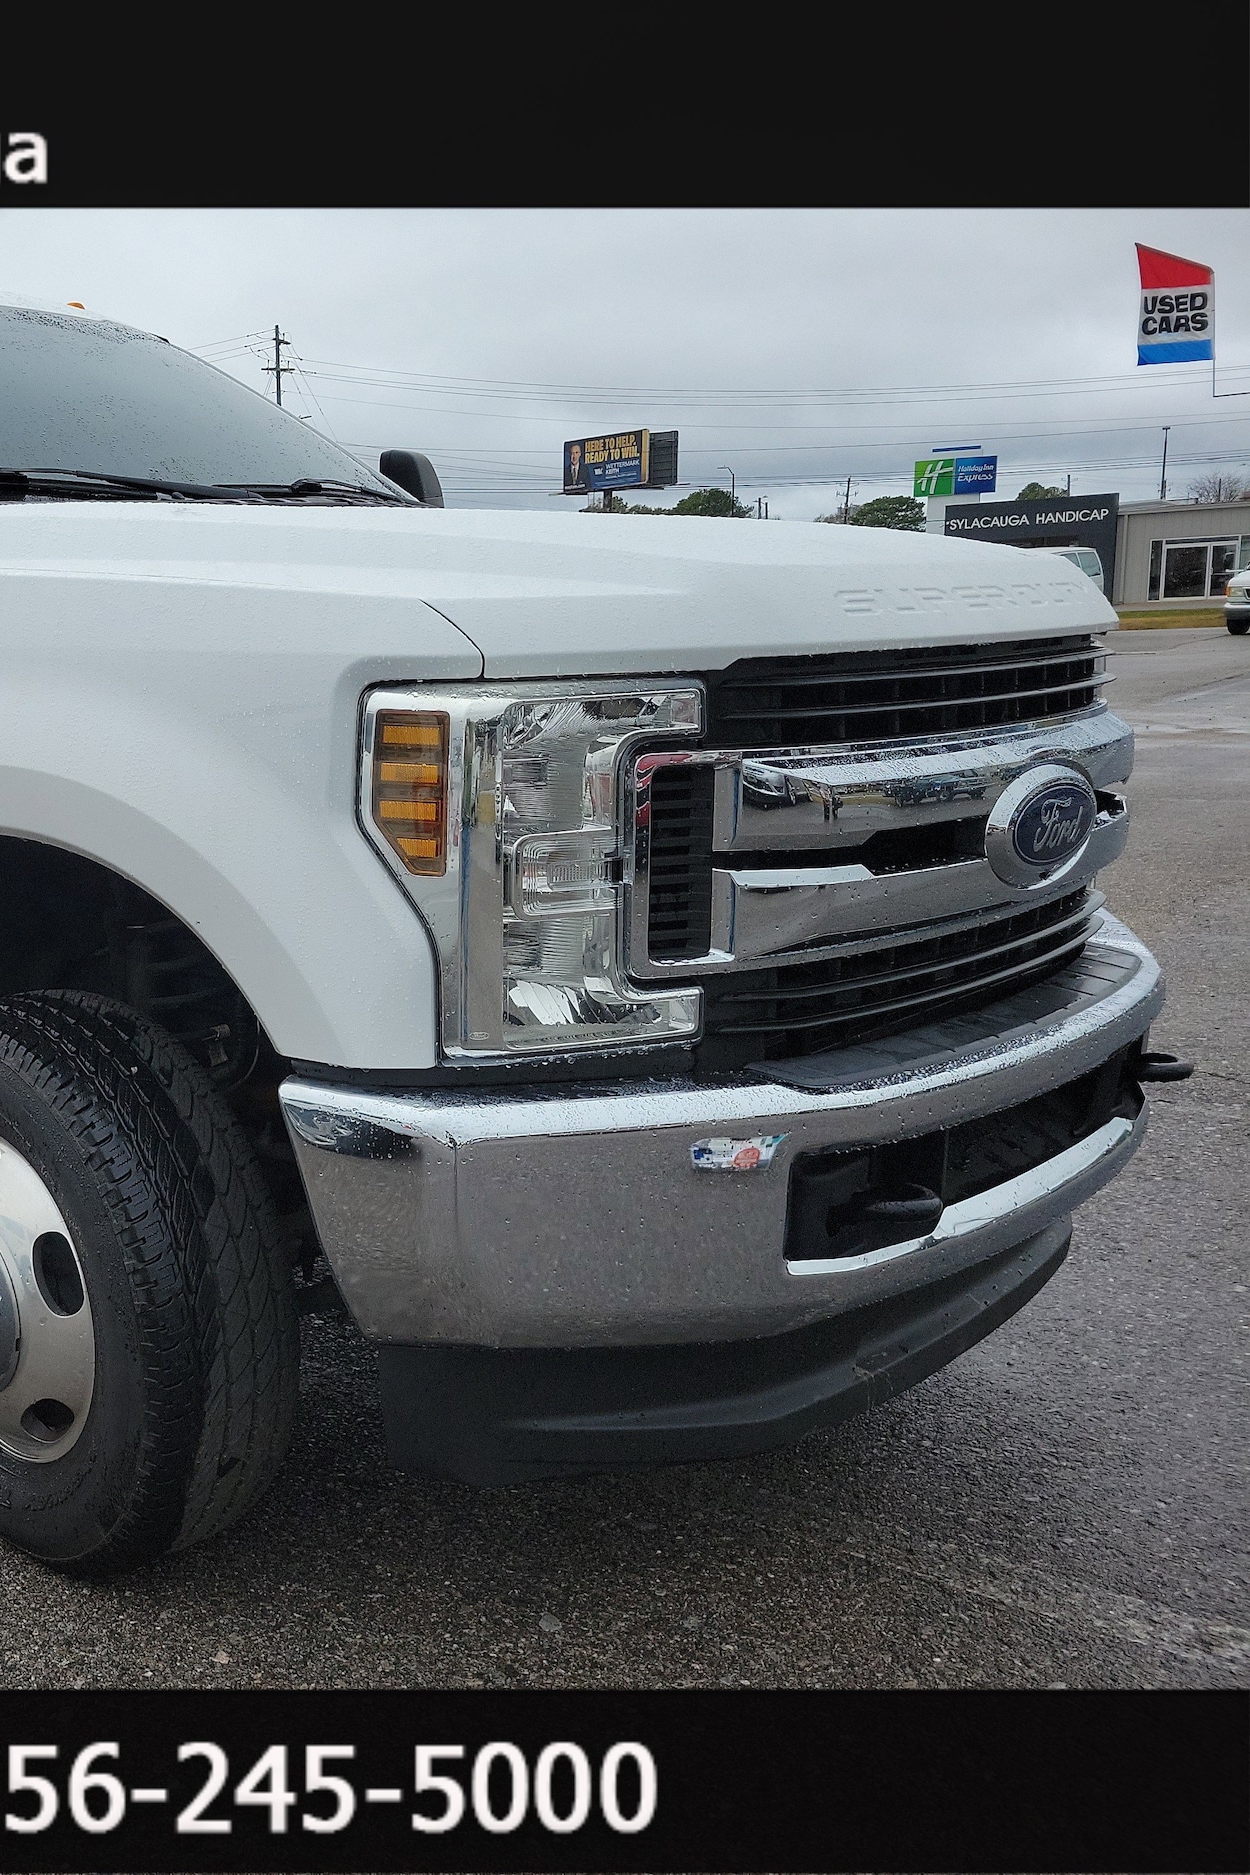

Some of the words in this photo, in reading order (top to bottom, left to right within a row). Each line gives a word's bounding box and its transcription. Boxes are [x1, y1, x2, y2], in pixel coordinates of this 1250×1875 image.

[1144, 292, 1208, 314] USED
[1142, 313, 1209, 335] CARS
[585, 440, 604, 452] HERE
[605, 438, 616, 449] TO
[616, 434, 636, 448] HELP.
[585, 450, 609, 464] READY
[610, 449, 620, 460] TO
[621, 446, 640, 459] WIN.
[957, 472, 993, 483] Express
[958, 464, 983, 473] Holiday
[983, 463, 994, 471] Inn
[949, 513, 1030, 531] SYLACAUGA
[1035, 508, 1109, 525] HANDICAP
[1033, 797, 1083, 852] Ford
